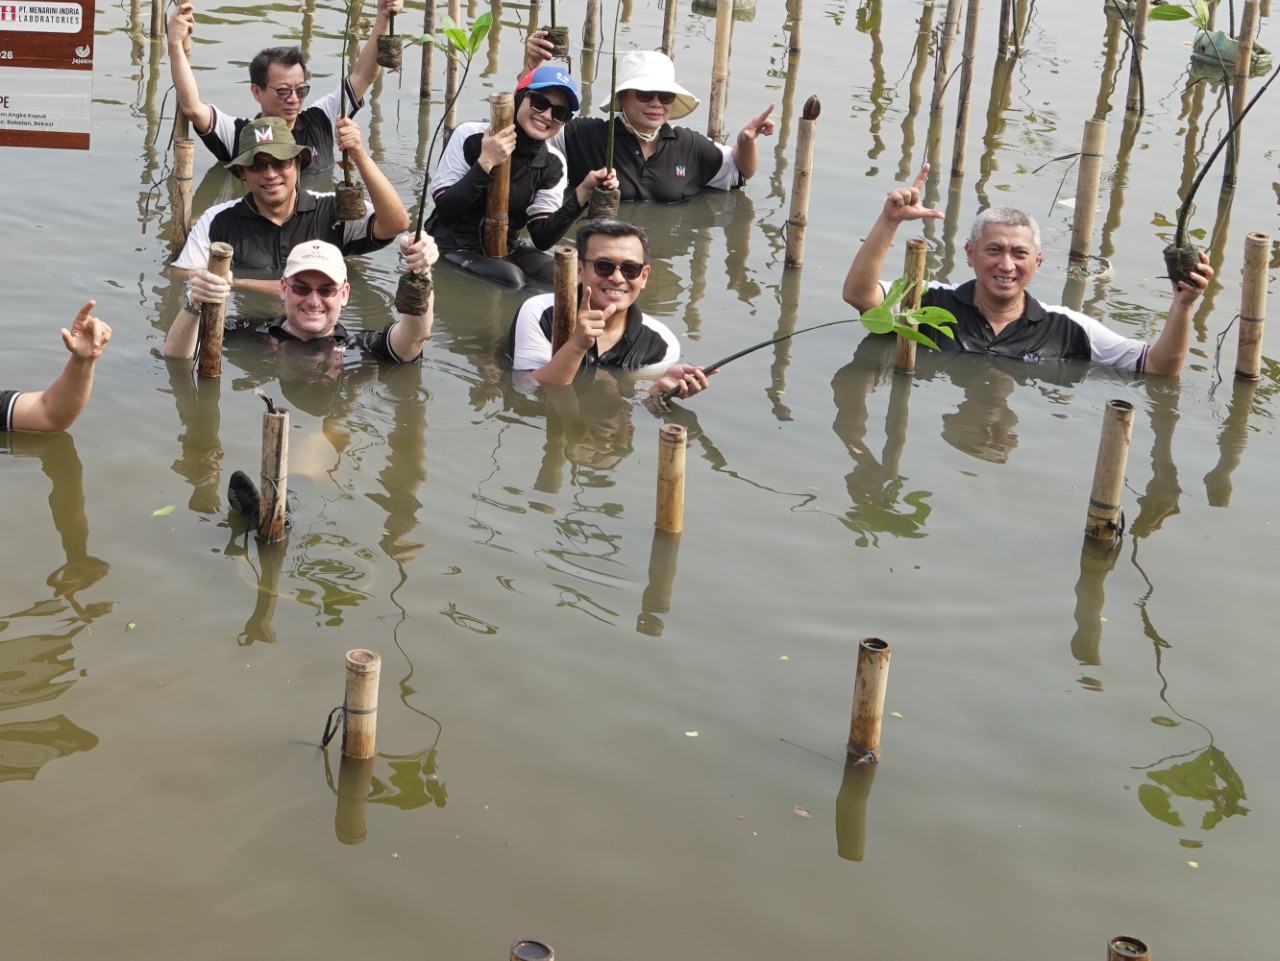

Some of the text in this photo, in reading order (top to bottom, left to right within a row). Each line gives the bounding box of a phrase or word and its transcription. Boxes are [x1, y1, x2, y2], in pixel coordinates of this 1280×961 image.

[18, 6, 80, 16] PT. MENARINI INDRIA
[18, 15, 80, 25] LABORATORIES
